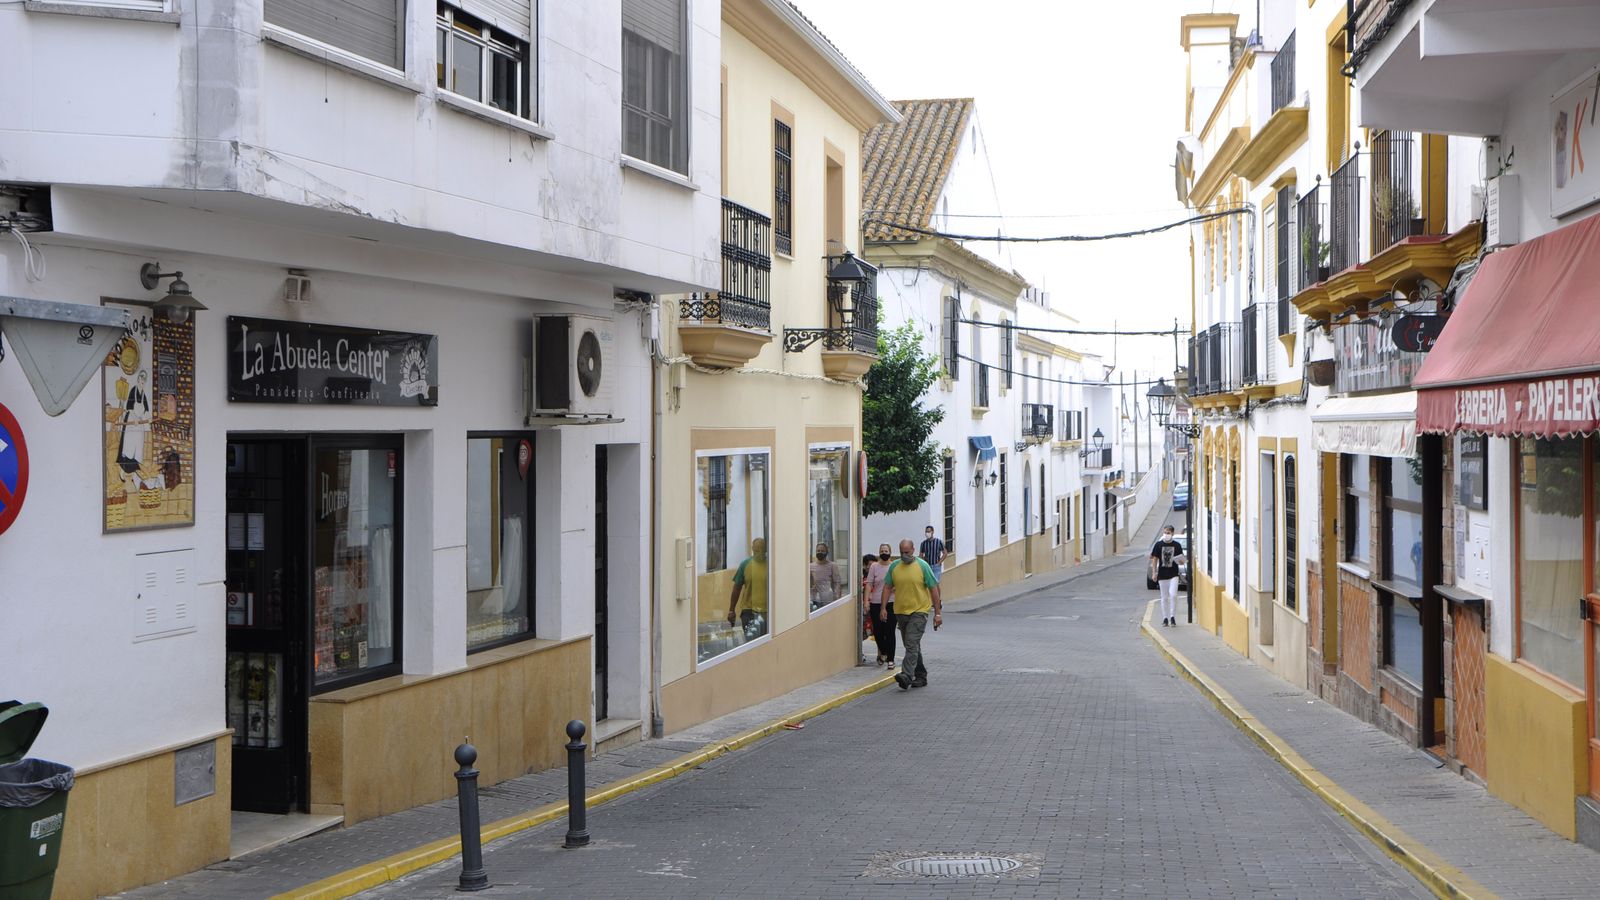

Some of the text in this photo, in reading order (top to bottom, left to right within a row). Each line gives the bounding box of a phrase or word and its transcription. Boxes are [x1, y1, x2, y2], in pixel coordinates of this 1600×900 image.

[241, 324, 265, 380] La
[270, 331, 331, 372] Abuela
[336, 338, 390, 385] Center
[1455, 388, 1507, 425] LIBRERIA
[321, 472, 348, 519] Horno
